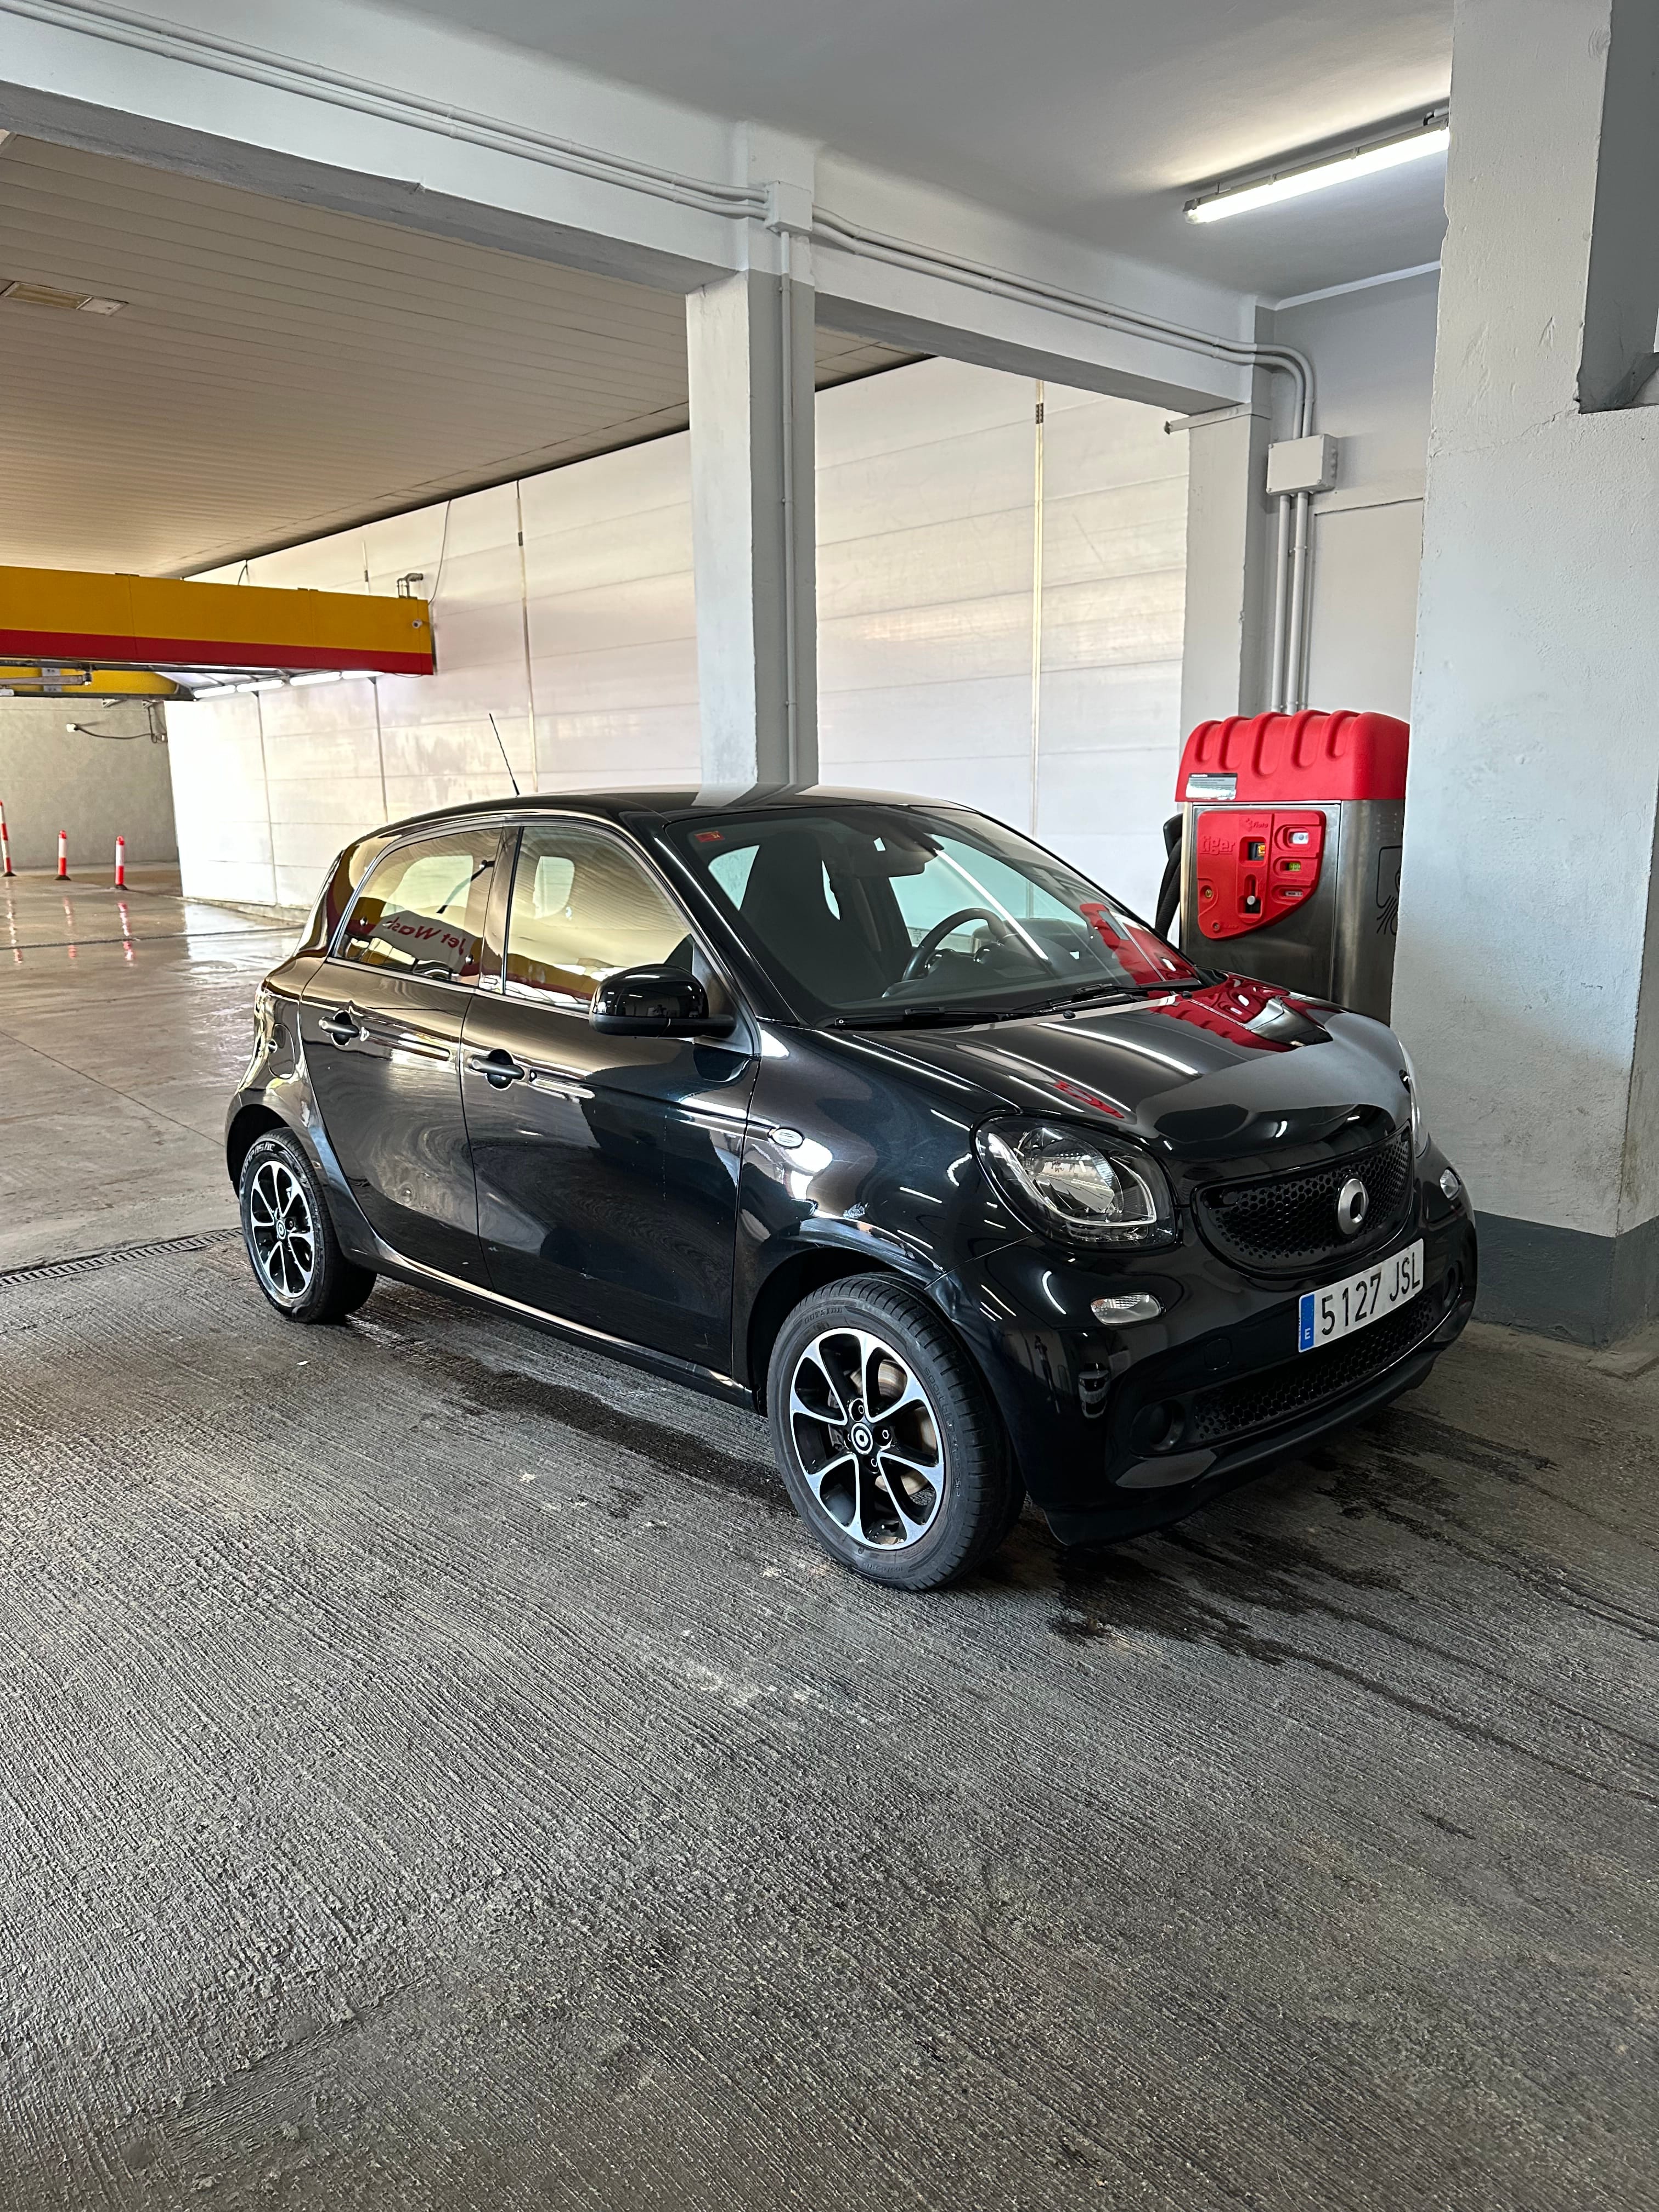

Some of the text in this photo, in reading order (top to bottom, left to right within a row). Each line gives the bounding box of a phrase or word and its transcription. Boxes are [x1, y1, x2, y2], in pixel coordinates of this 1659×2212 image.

[1321, 1252, 1420, 1335] 5127 JSL
[1304, 1328, 1311, 1340] E
